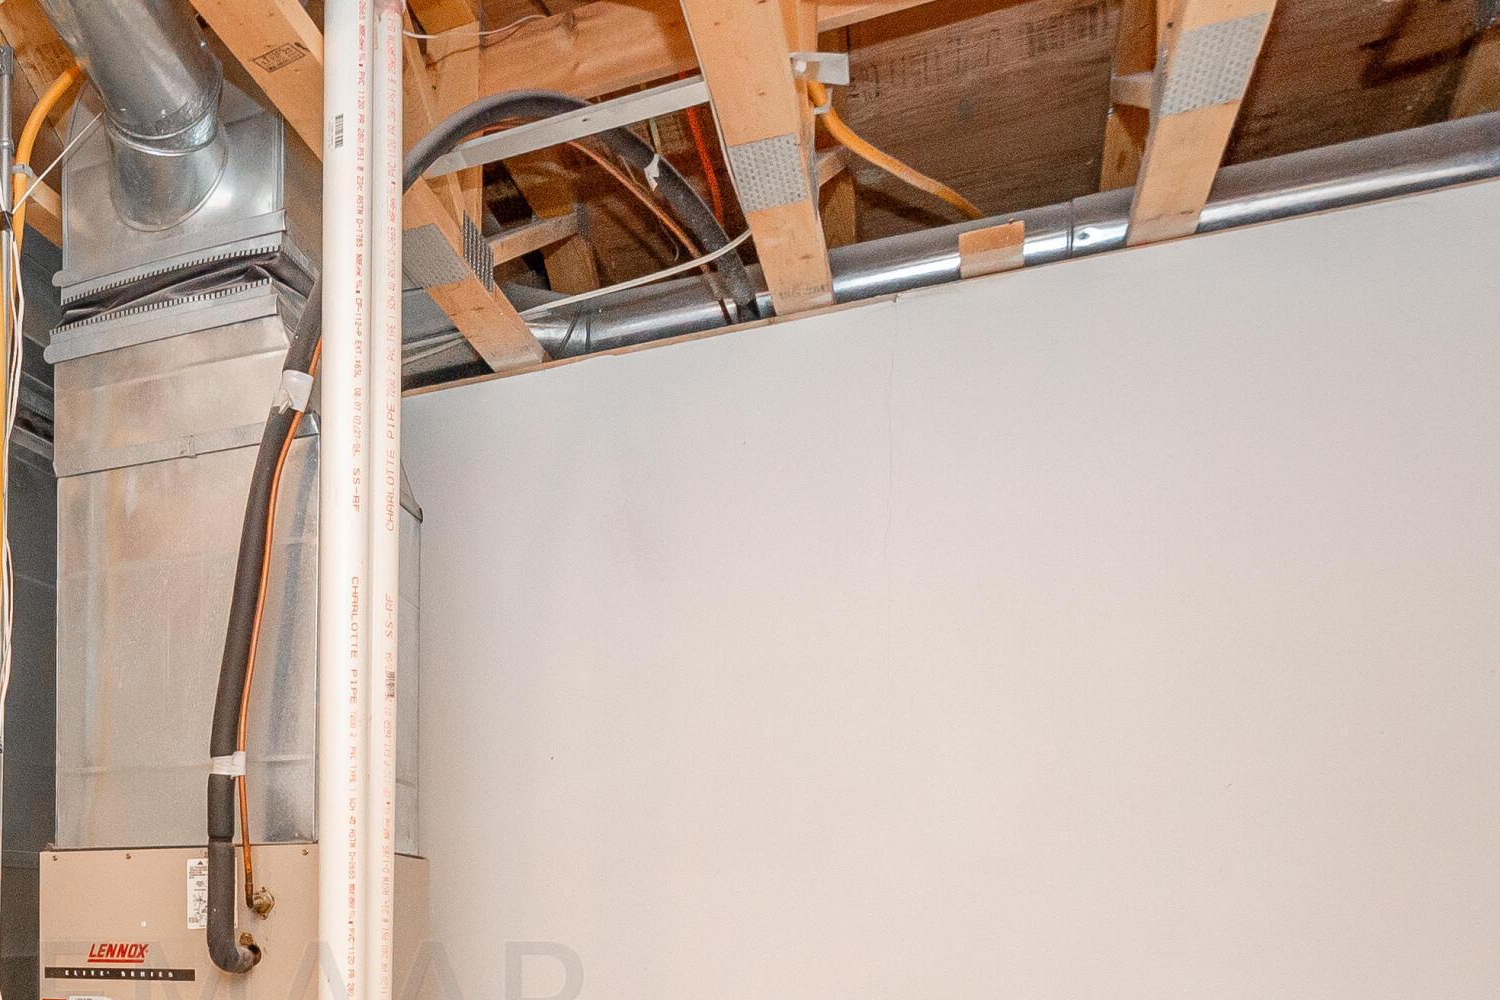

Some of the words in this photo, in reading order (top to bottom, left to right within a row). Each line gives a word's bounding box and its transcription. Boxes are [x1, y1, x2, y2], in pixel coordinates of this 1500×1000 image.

[387, 402, 396, 440] PIPE
[386, 449, 395, 531] CHARLOTTE
[350, 576, 360, 659] CHARLOTTE
[350, 669, 359, 705] PIPE
[88, 943, 149, 958] LENNOX
[120, 971, 174, 979] SERIES
